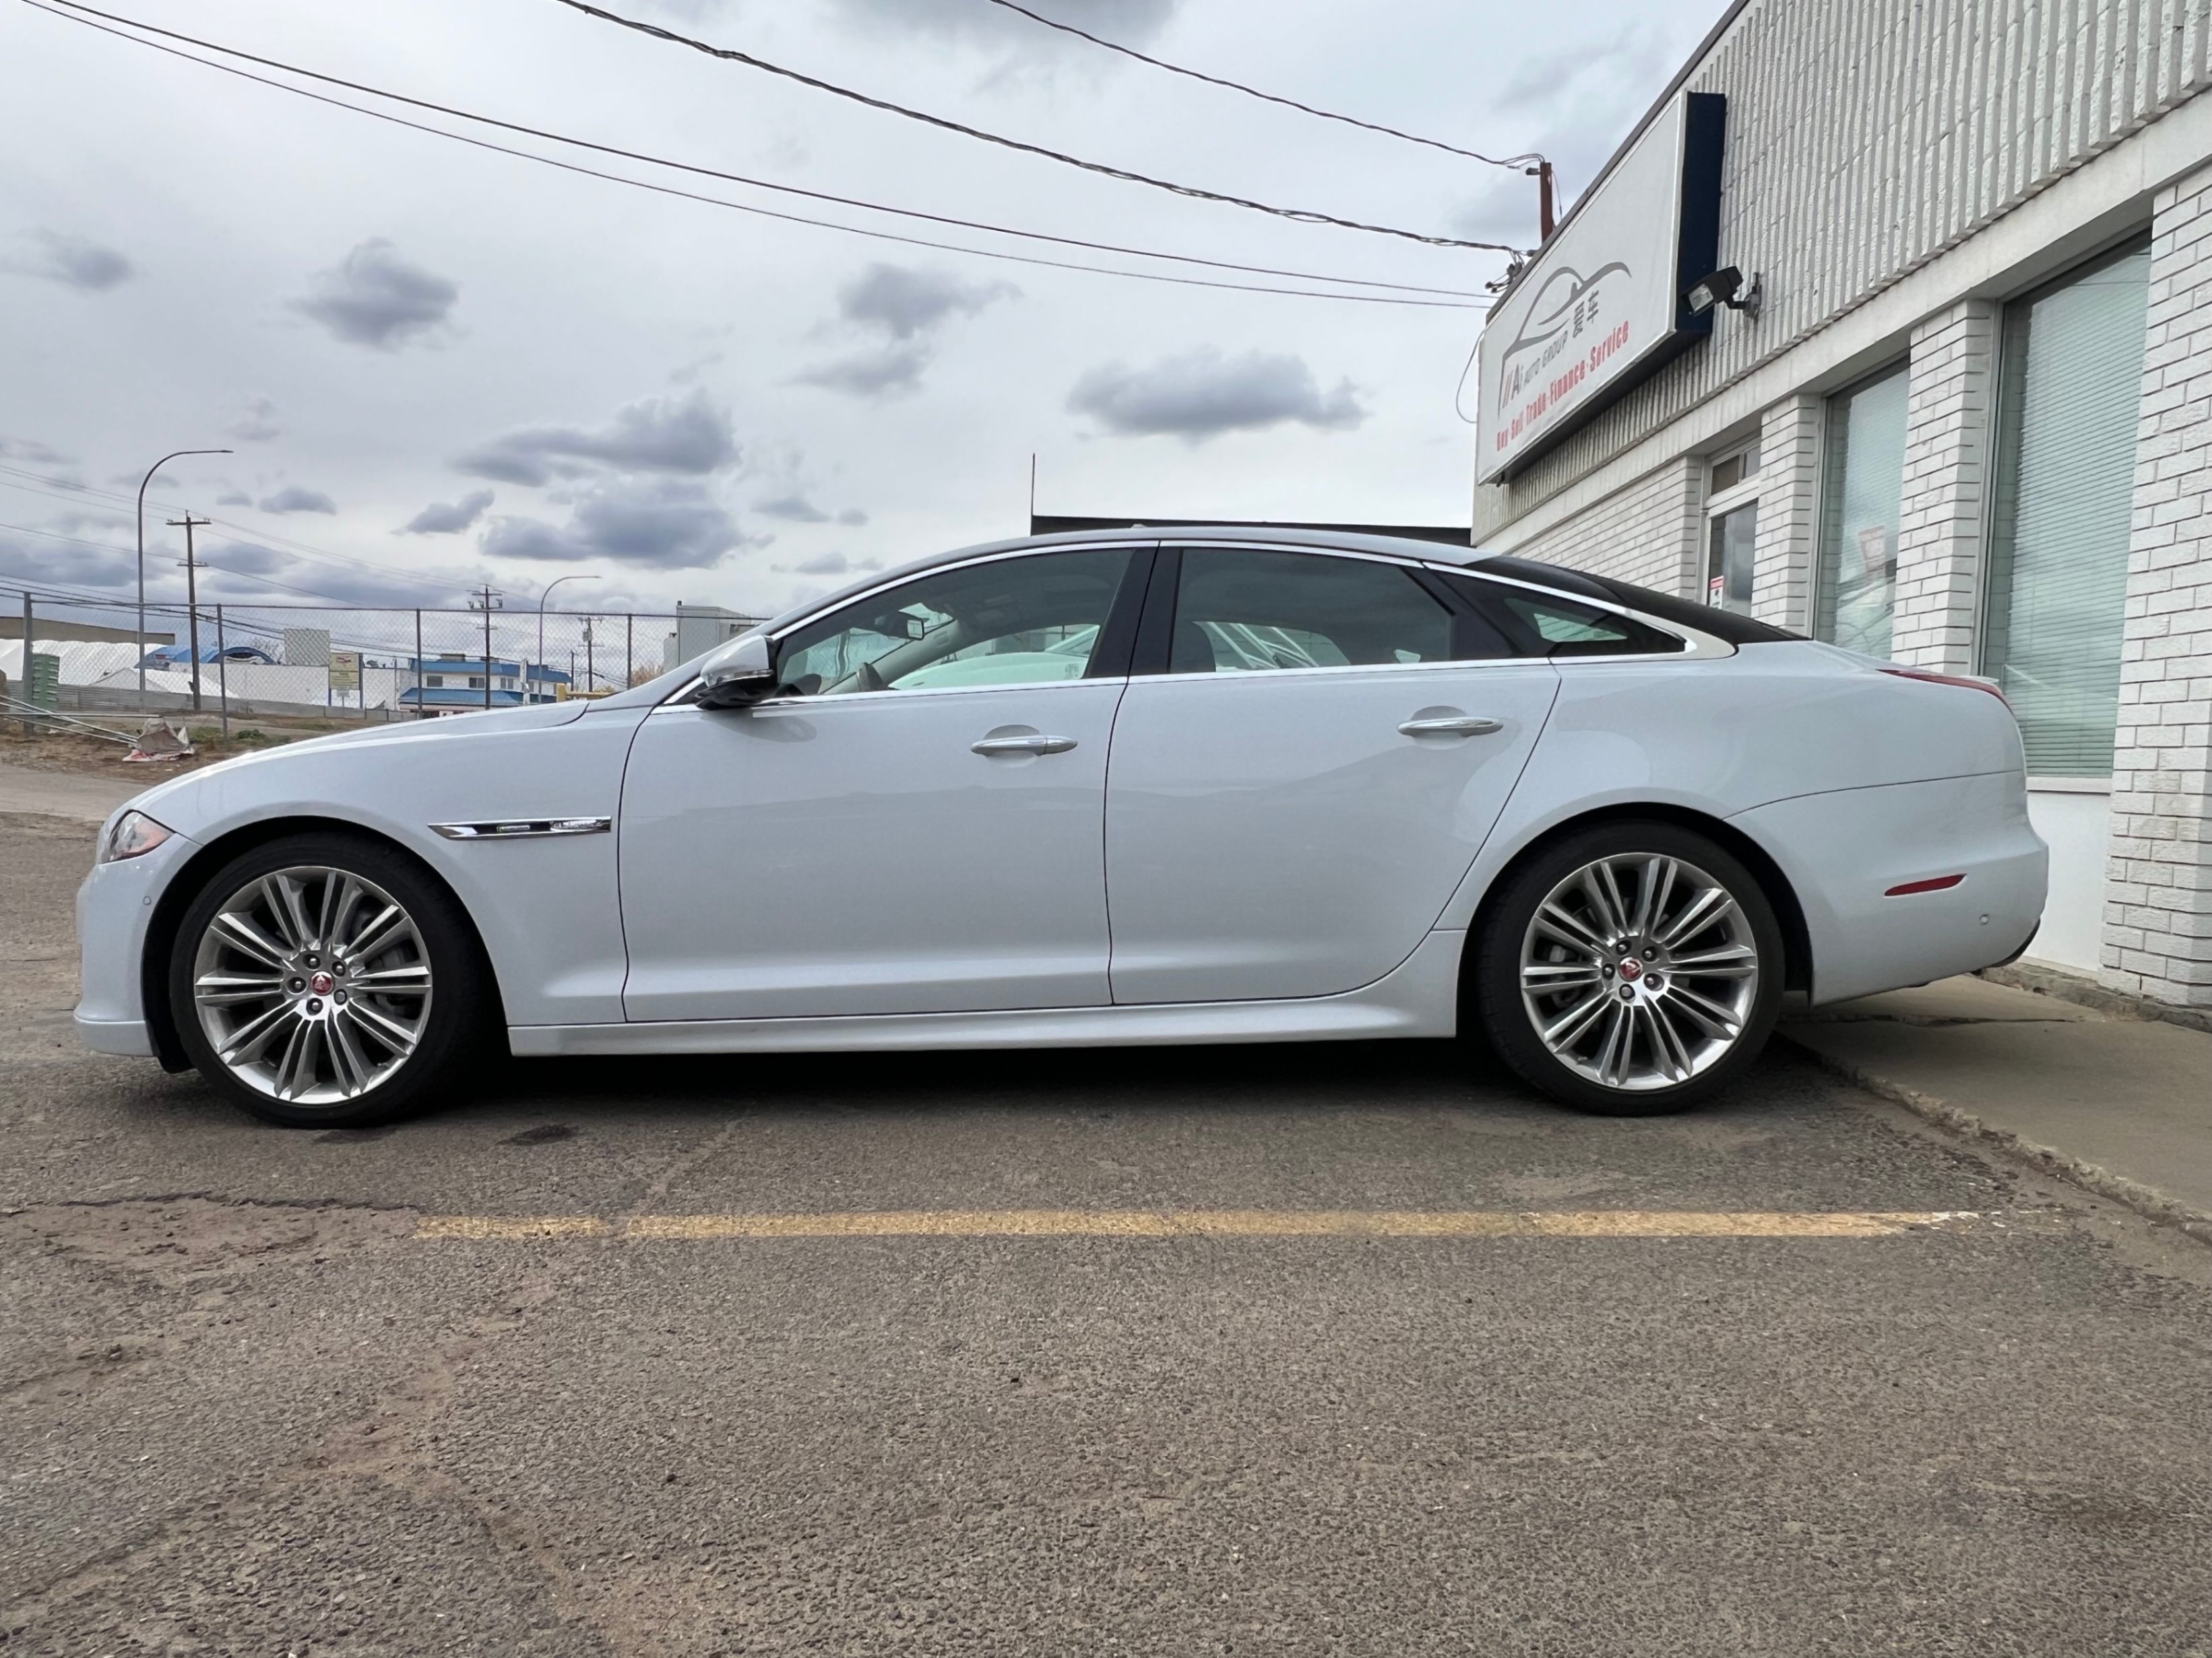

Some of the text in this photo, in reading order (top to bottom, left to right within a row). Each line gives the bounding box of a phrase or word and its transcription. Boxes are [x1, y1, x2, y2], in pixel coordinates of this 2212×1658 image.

[1524, 357, 1541, 388] AUTO
[1542, 329, 1569, 368] GROUP
[1526, 392, 1547, 426] Trade
[1550, 359, 1585, 406] Finance
[1590, 320, 1629, 373] Service
